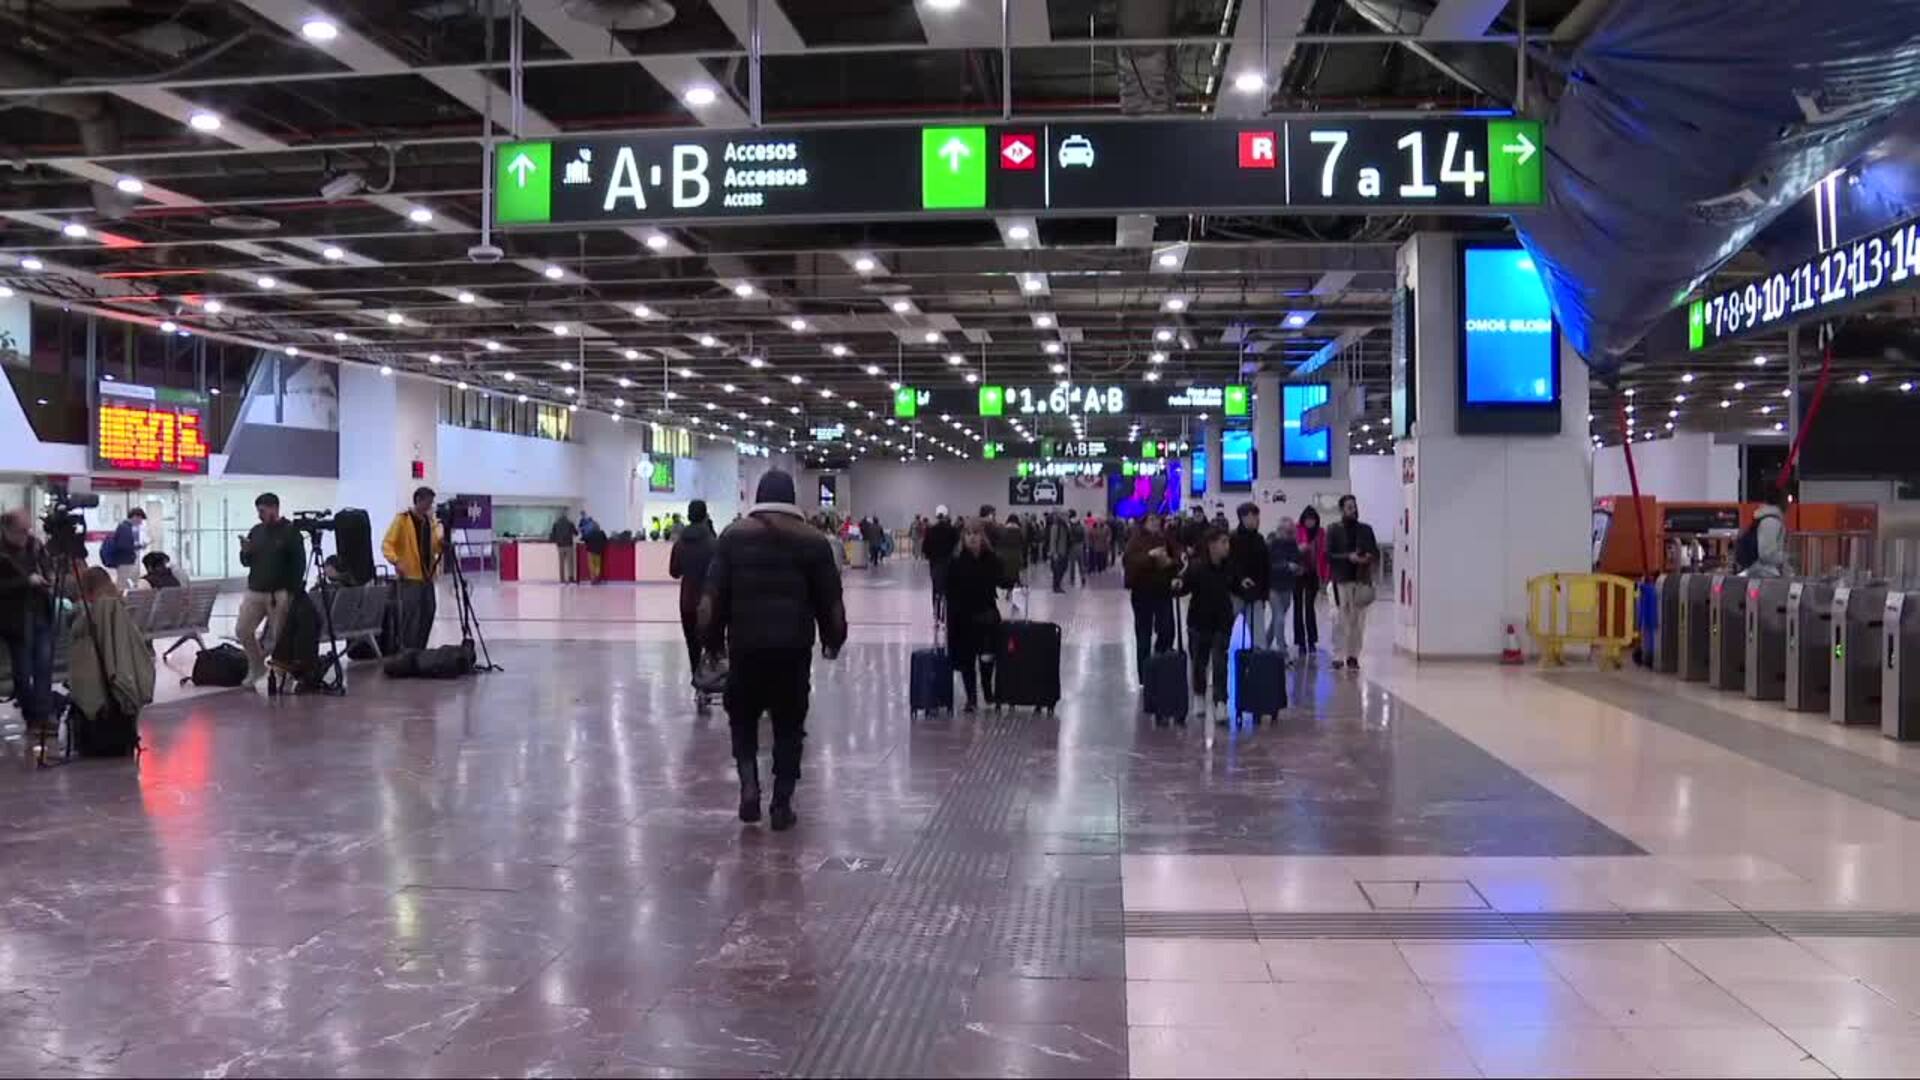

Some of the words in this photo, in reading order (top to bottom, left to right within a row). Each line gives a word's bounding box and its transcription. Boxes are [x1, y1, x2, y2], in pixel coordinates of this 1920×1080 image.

[724, 142, 797, 162] Accesos
[1252, 137, 1273, 160] R
[1310, 131, 1348, 197] 7
[1358, 168, 1380, 197] a
[1397, 131, 1485, 197] 14
